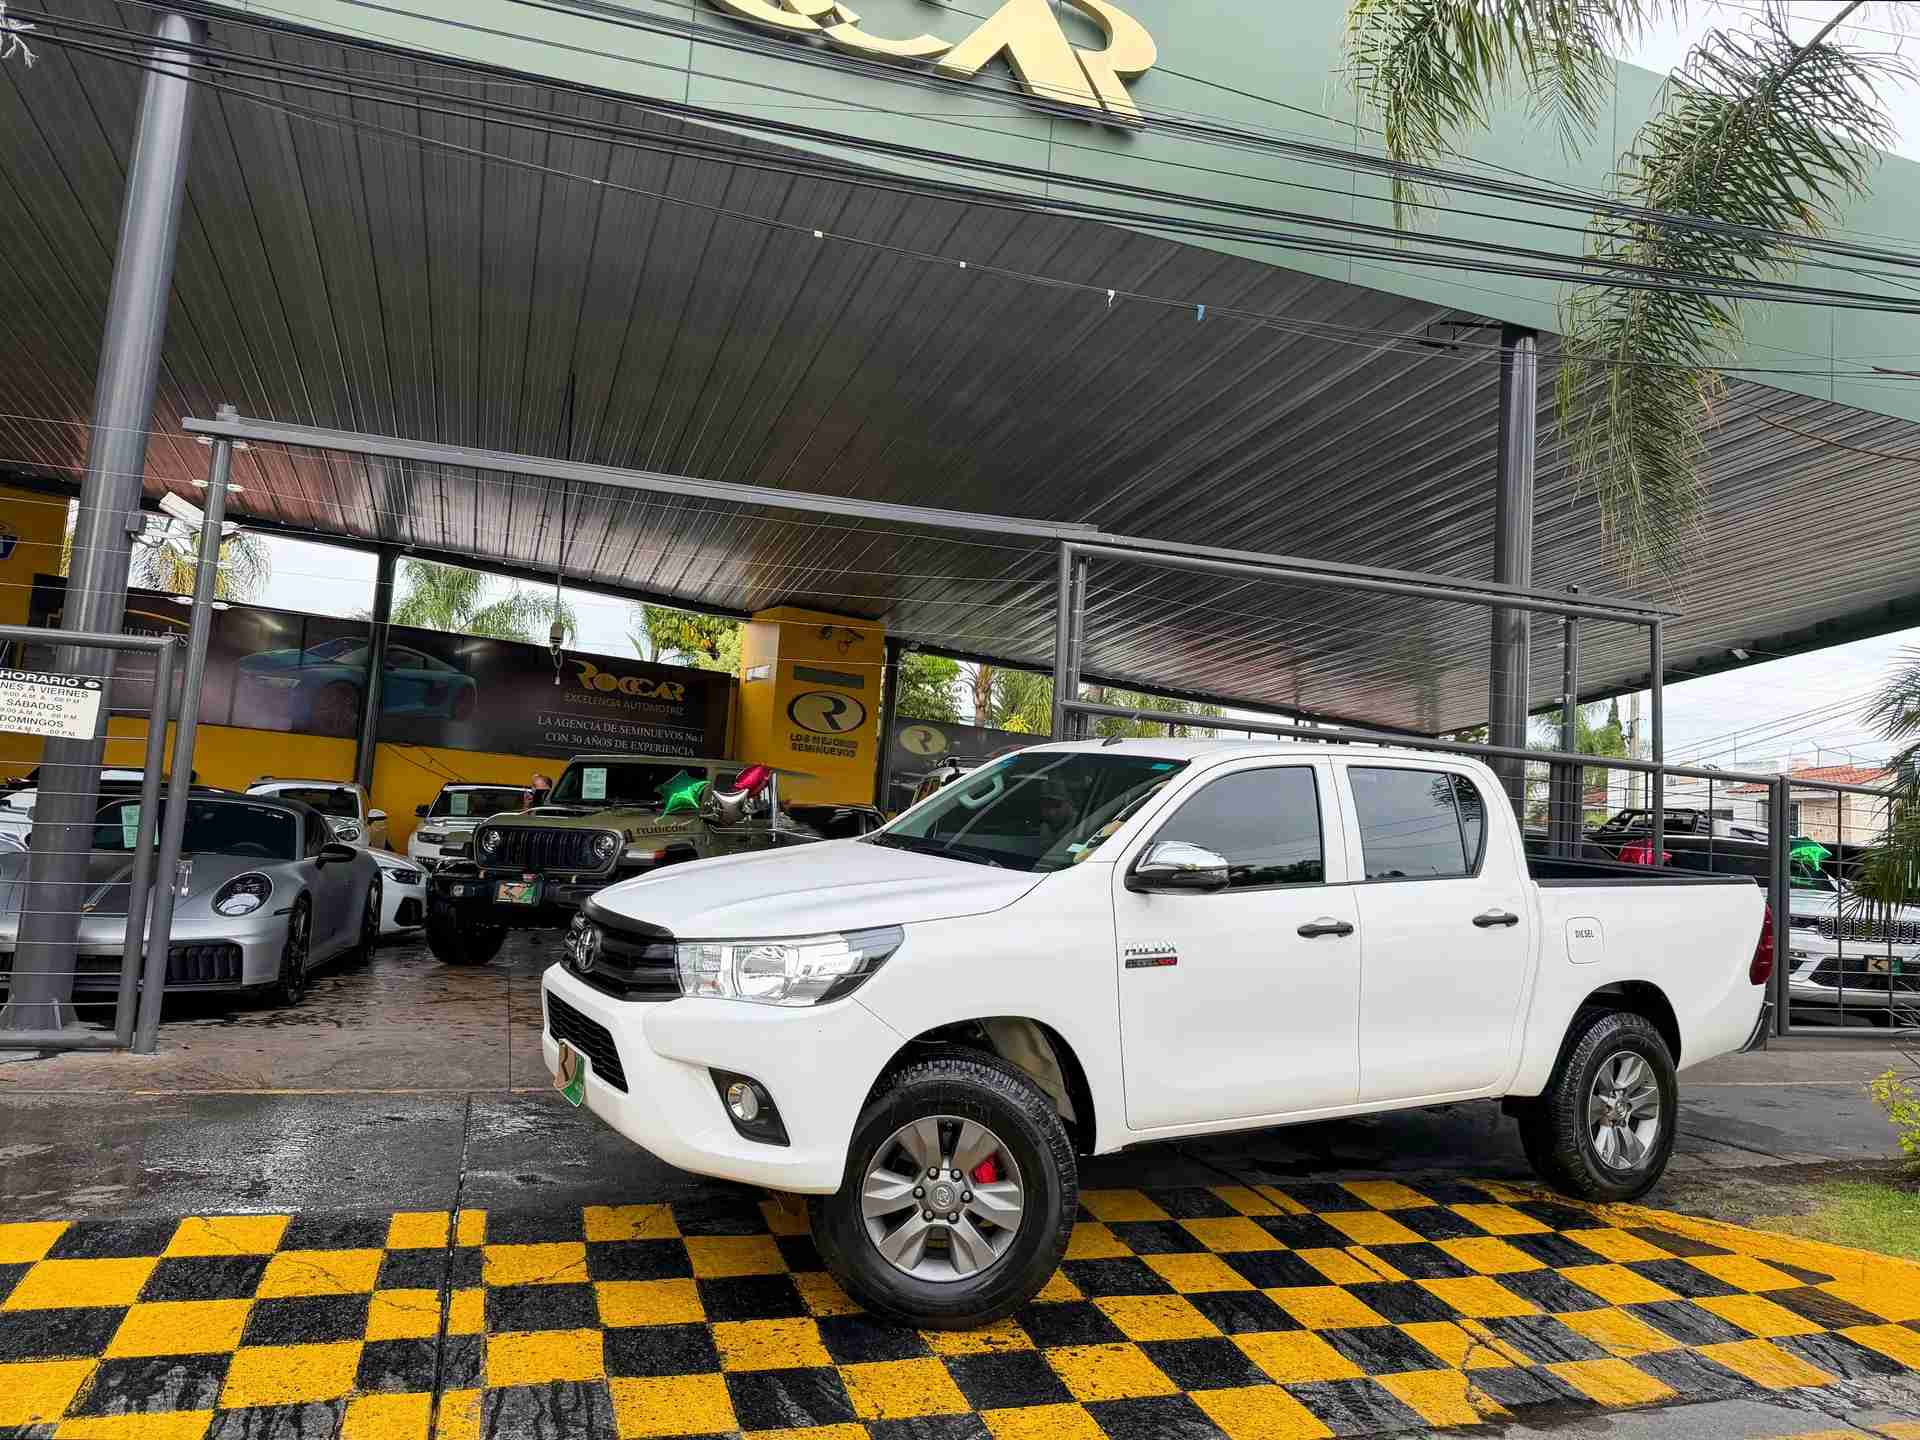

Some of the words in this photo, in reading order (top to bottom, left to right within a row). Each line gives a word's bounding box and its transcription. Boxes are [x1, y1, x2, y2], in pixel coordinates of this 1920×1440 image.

[0, 669, 79, 687] HORARIO
[40, 686, 89, 698] VIERNES
[0, 715, 64, 728] DOMINGOS
[537, 715, 552, 726] LA
[555, 717, 601, 732] AGENCIA
[603, 721, 618, 734] DE
[620, 724, 684, 742] SEMINUEVOS
[545, 731, 569, 744] CON
[614, 738, 628, 750] DE
[630, 739, 695, 757] EXPERIENCIA
[1575, 929, 1594, 938] DIESEL
